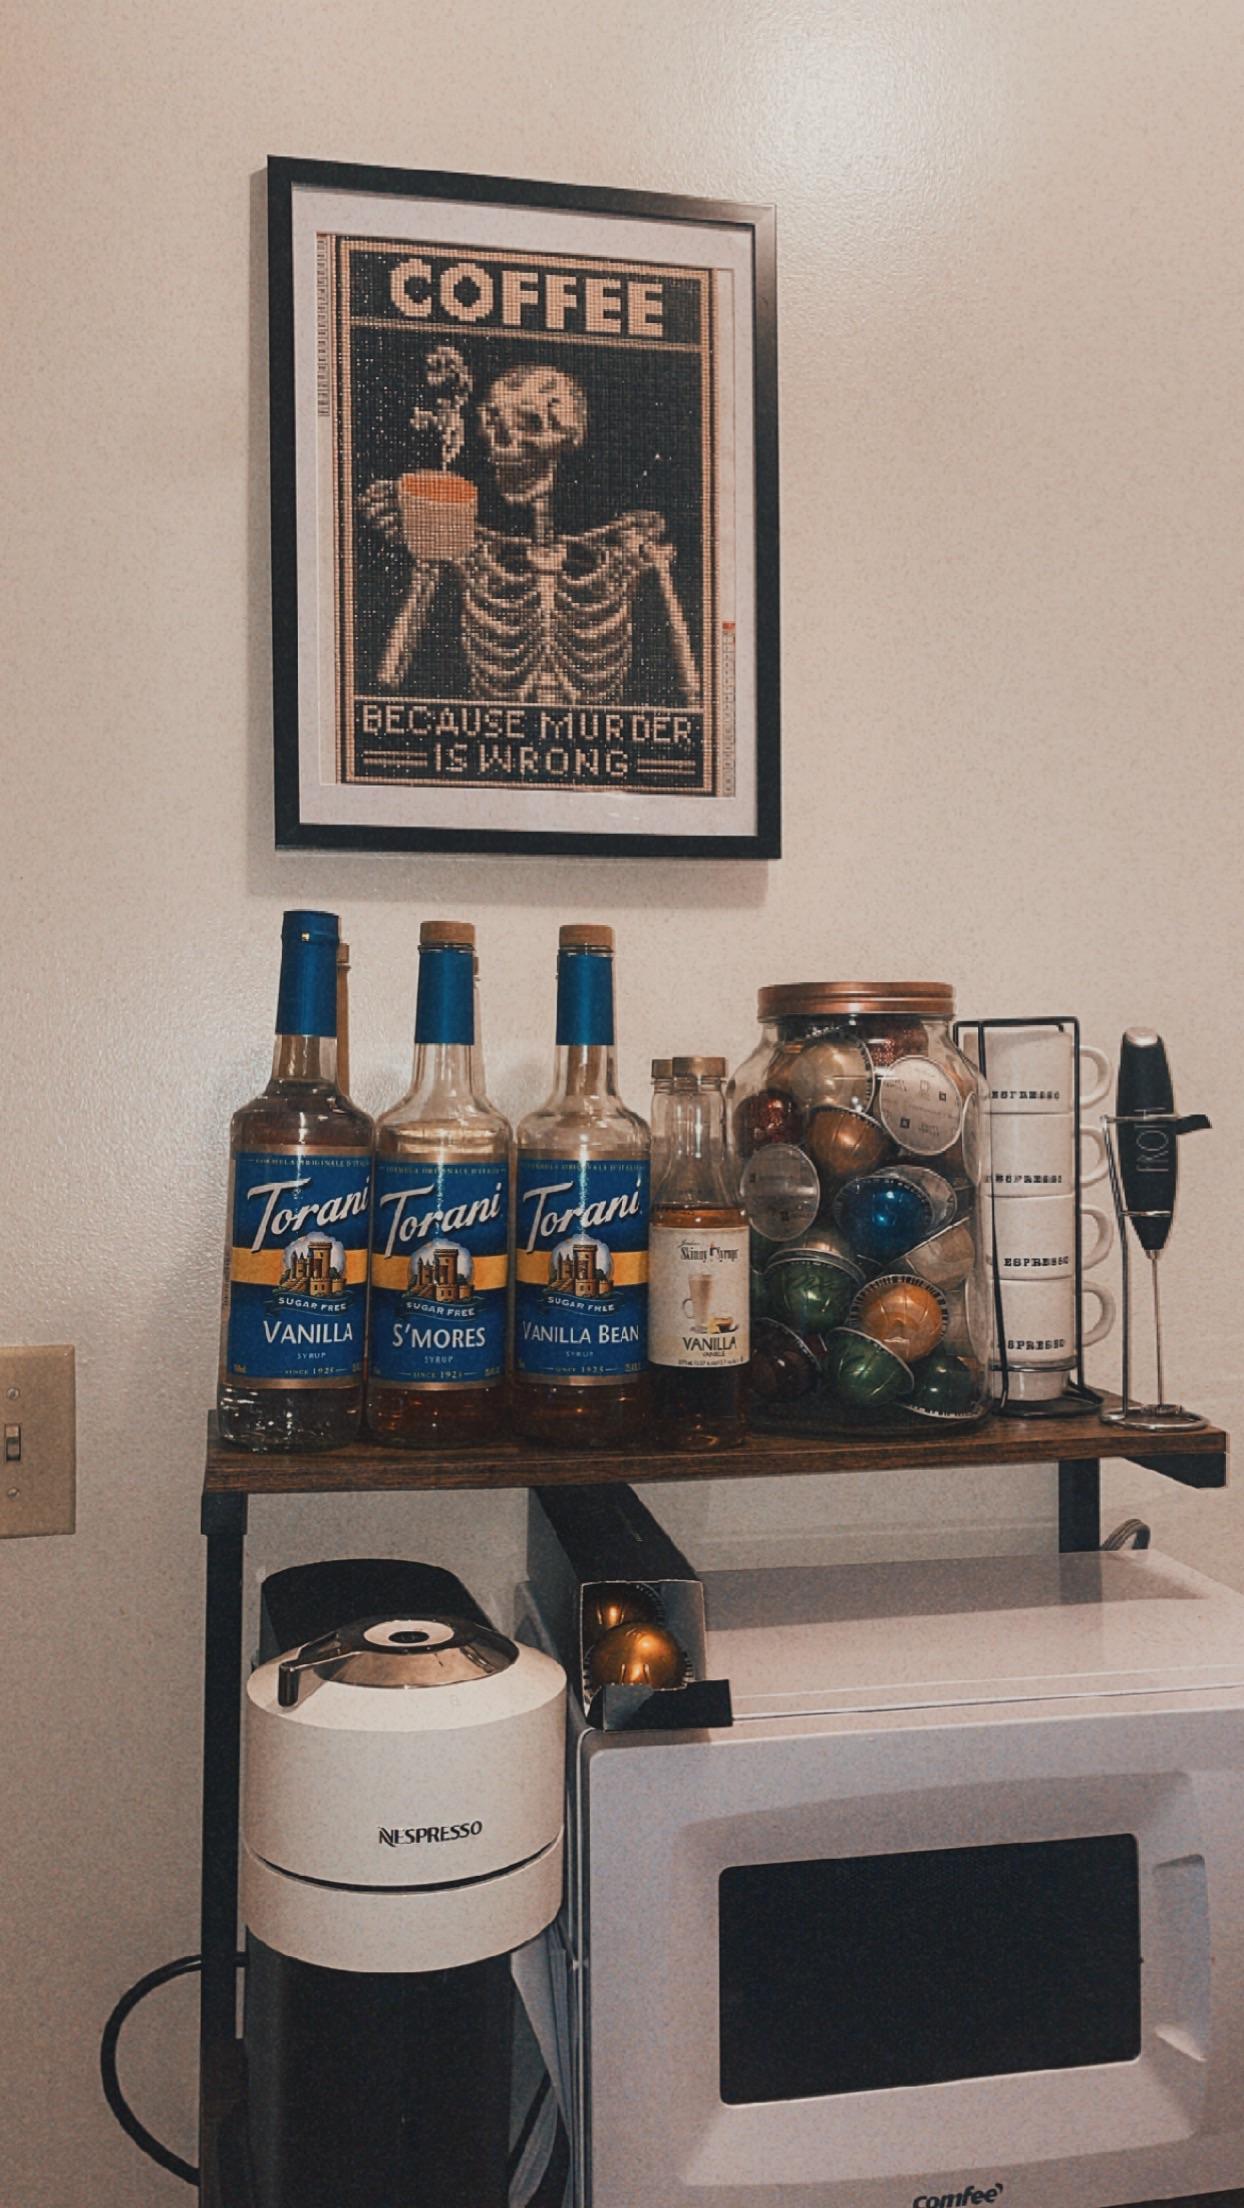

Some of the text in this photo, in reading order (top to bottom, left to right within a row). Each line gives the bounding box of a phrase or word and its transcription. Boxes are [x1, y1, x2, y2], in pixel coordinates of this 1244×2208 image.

[390, 258, 663, 337] COFFEE
[362, 704, 692, 743] BECAUSE MURDER
[435, 743, 629, 776] IS WRONG
[247, 1176, 370, 1254] Torani
[380, 1182, 502, 1259] Torani
[523, 1178, 641, 1254] Torani
[278, 1297, 347, 1312] SUGAR FREE
[405, 1301, 476, 1317] SUGAR FREE
[547, 1296, 615, 1312] SUGAR FREE
[262, 1320, 353, 1344] VANILLA
[392, 1323, 486, 1349] S'MORES
[522, 1320, 639, 1344] VANILLA BEAN
[682, 1336, 736, 1351] VANILLA
[297, 1351, 327, 1360] SYRUP
[1006, 1339, 1065, 1350] SPRESSO
[424, 1355, 454, 1364] SYRUP
[378, 1820, 483, 1847] NESPRESSO
